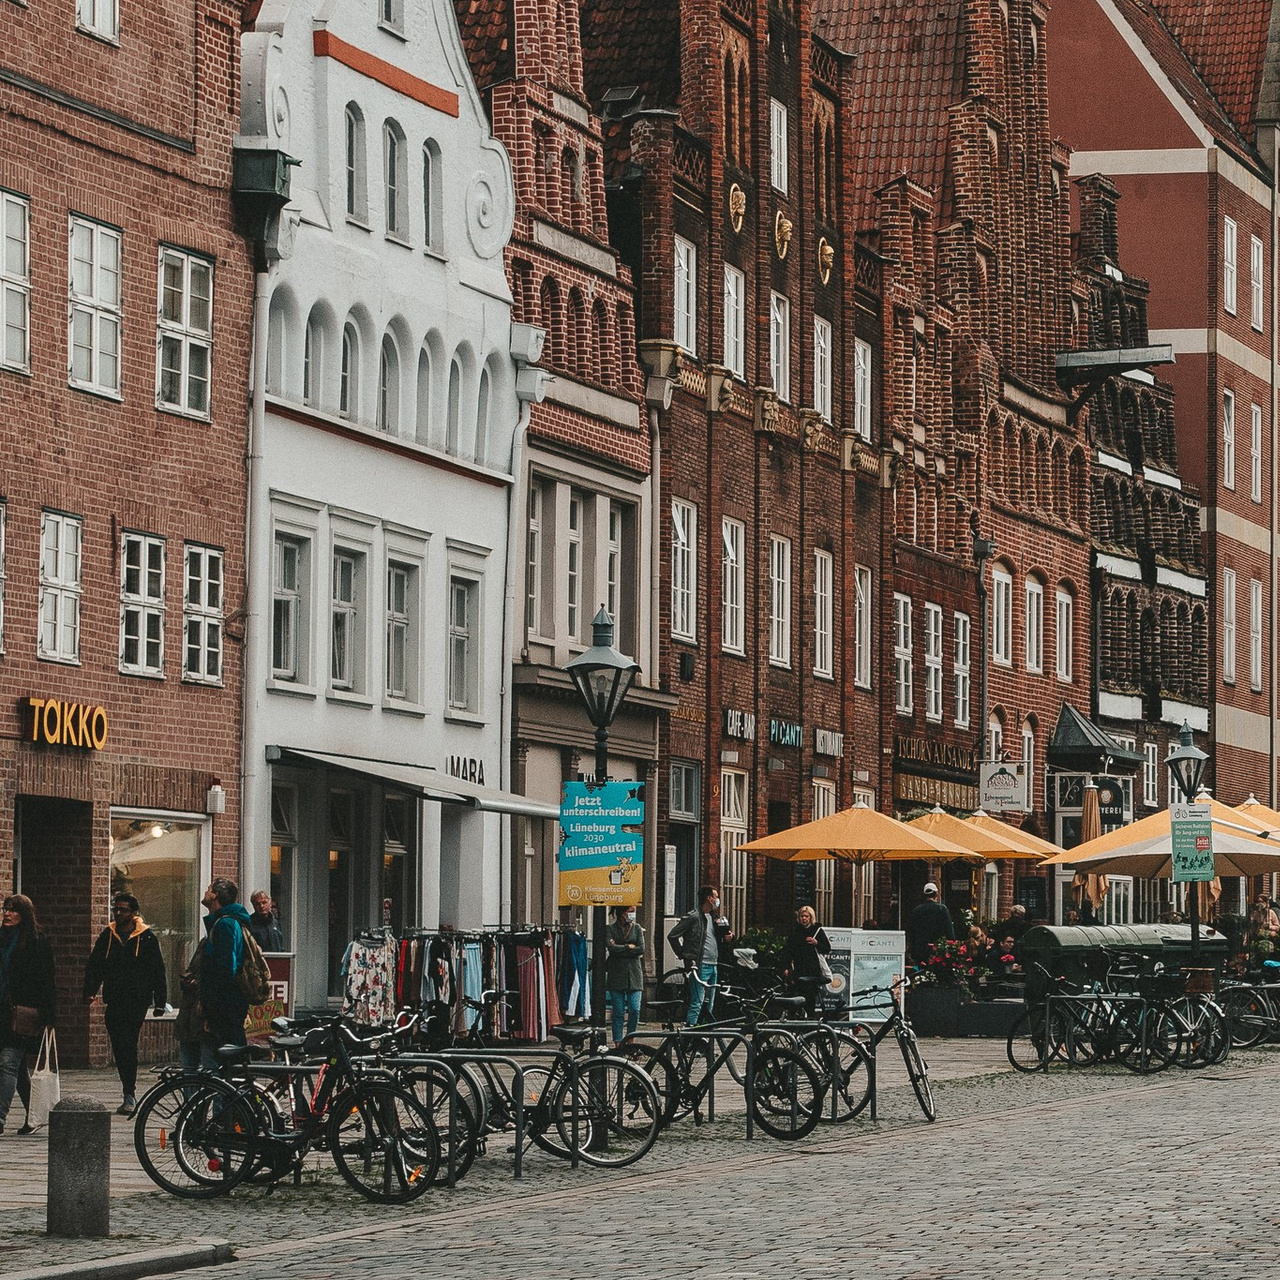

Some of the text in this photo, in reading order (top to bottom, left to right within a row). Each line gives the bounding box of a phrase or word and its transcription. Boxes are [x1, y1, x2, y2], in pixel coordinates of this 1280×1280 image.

[713, 784, 719, 798] 9
[574, 796, 602, 807] Jetzt
[563, 806, 641, 817] unterschreiben!
[570, 822, 616, 834] Lüneburg
[583, 834, 604, 843] 2030
[565, 841, 637, 858] klimaneutral
[585, 894, 623, 902] Lüneburg
